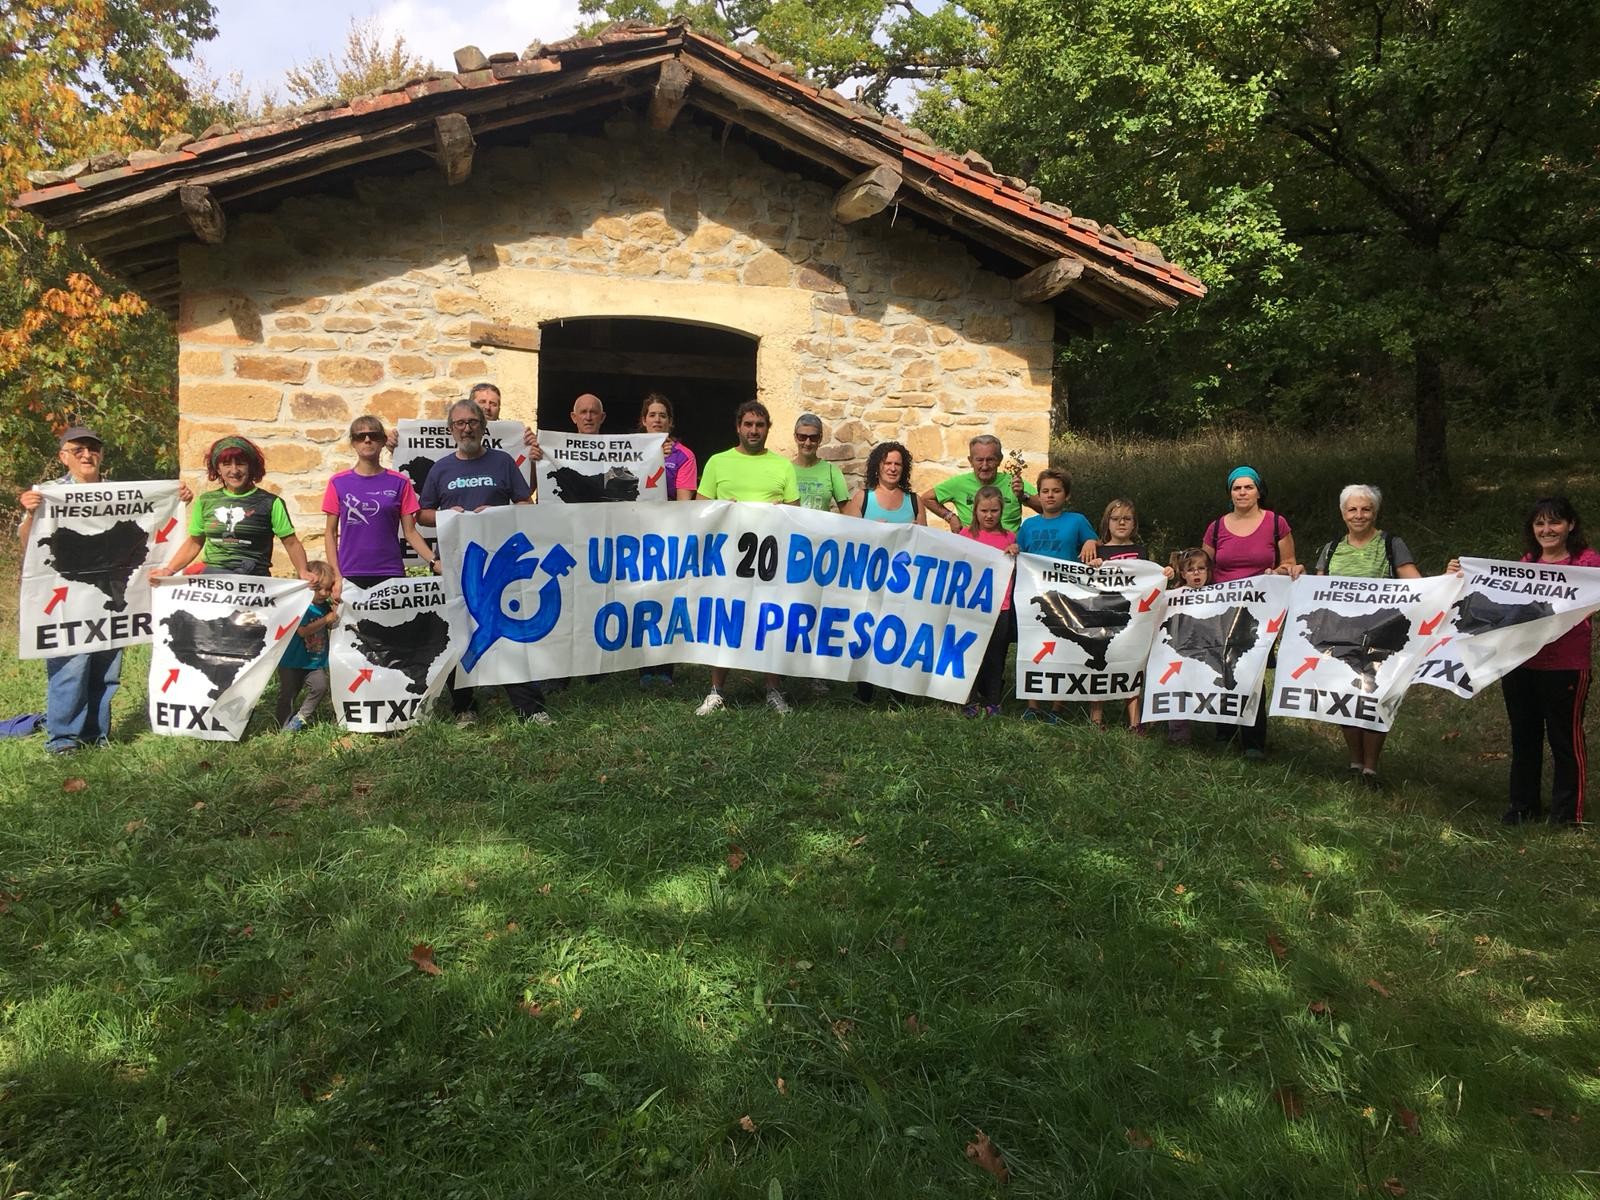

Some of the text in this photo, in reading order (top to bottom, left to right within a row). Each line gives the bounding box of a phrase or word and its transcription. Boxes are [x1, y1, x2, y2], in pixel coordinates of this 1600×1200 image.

[420, 426, 452, 436] PRES
[408, 438, 503, 449] IHESLAK
[566, 439, 632, 450] PRESO ETA
[554, 449, 644, 463] IHESLARIAK
[65, 489, 144, 504] PRESO ETA
[50, 501, 155, 519] IHESLARIAK
[588, 531, 994, 614] URRIAK 20 DONOSTIRA
[1053, 562, 1124, 576] PRESO ETA
[1490, 565, 1567, 583] PRESO ETA
[188, 578, 266, 594] PRESO ETA
[369, 581, 440, 600] PRESO ETA
[1228, 579, 1254, 590] ETA
[1329, 580, 1411, 593] PRESO ETA
[1470, 574, 1579, 601] IHESLARIAK
[171, 588, 277, 608] IHESLARIAK
[1167, 591, 1267, 607] IHESLARIAK
[1313, 590, 1423, 604] IHESLARIAK
[36, 612, 154, 650] ETXER
[593, 596, 978, 680] ORAIN PRESOAK
[1024, 670, 1144, 695] ETXERA
[1152, 691, 1250, 717] ETXE
[1278, 686, 1385, 724] ETXE
